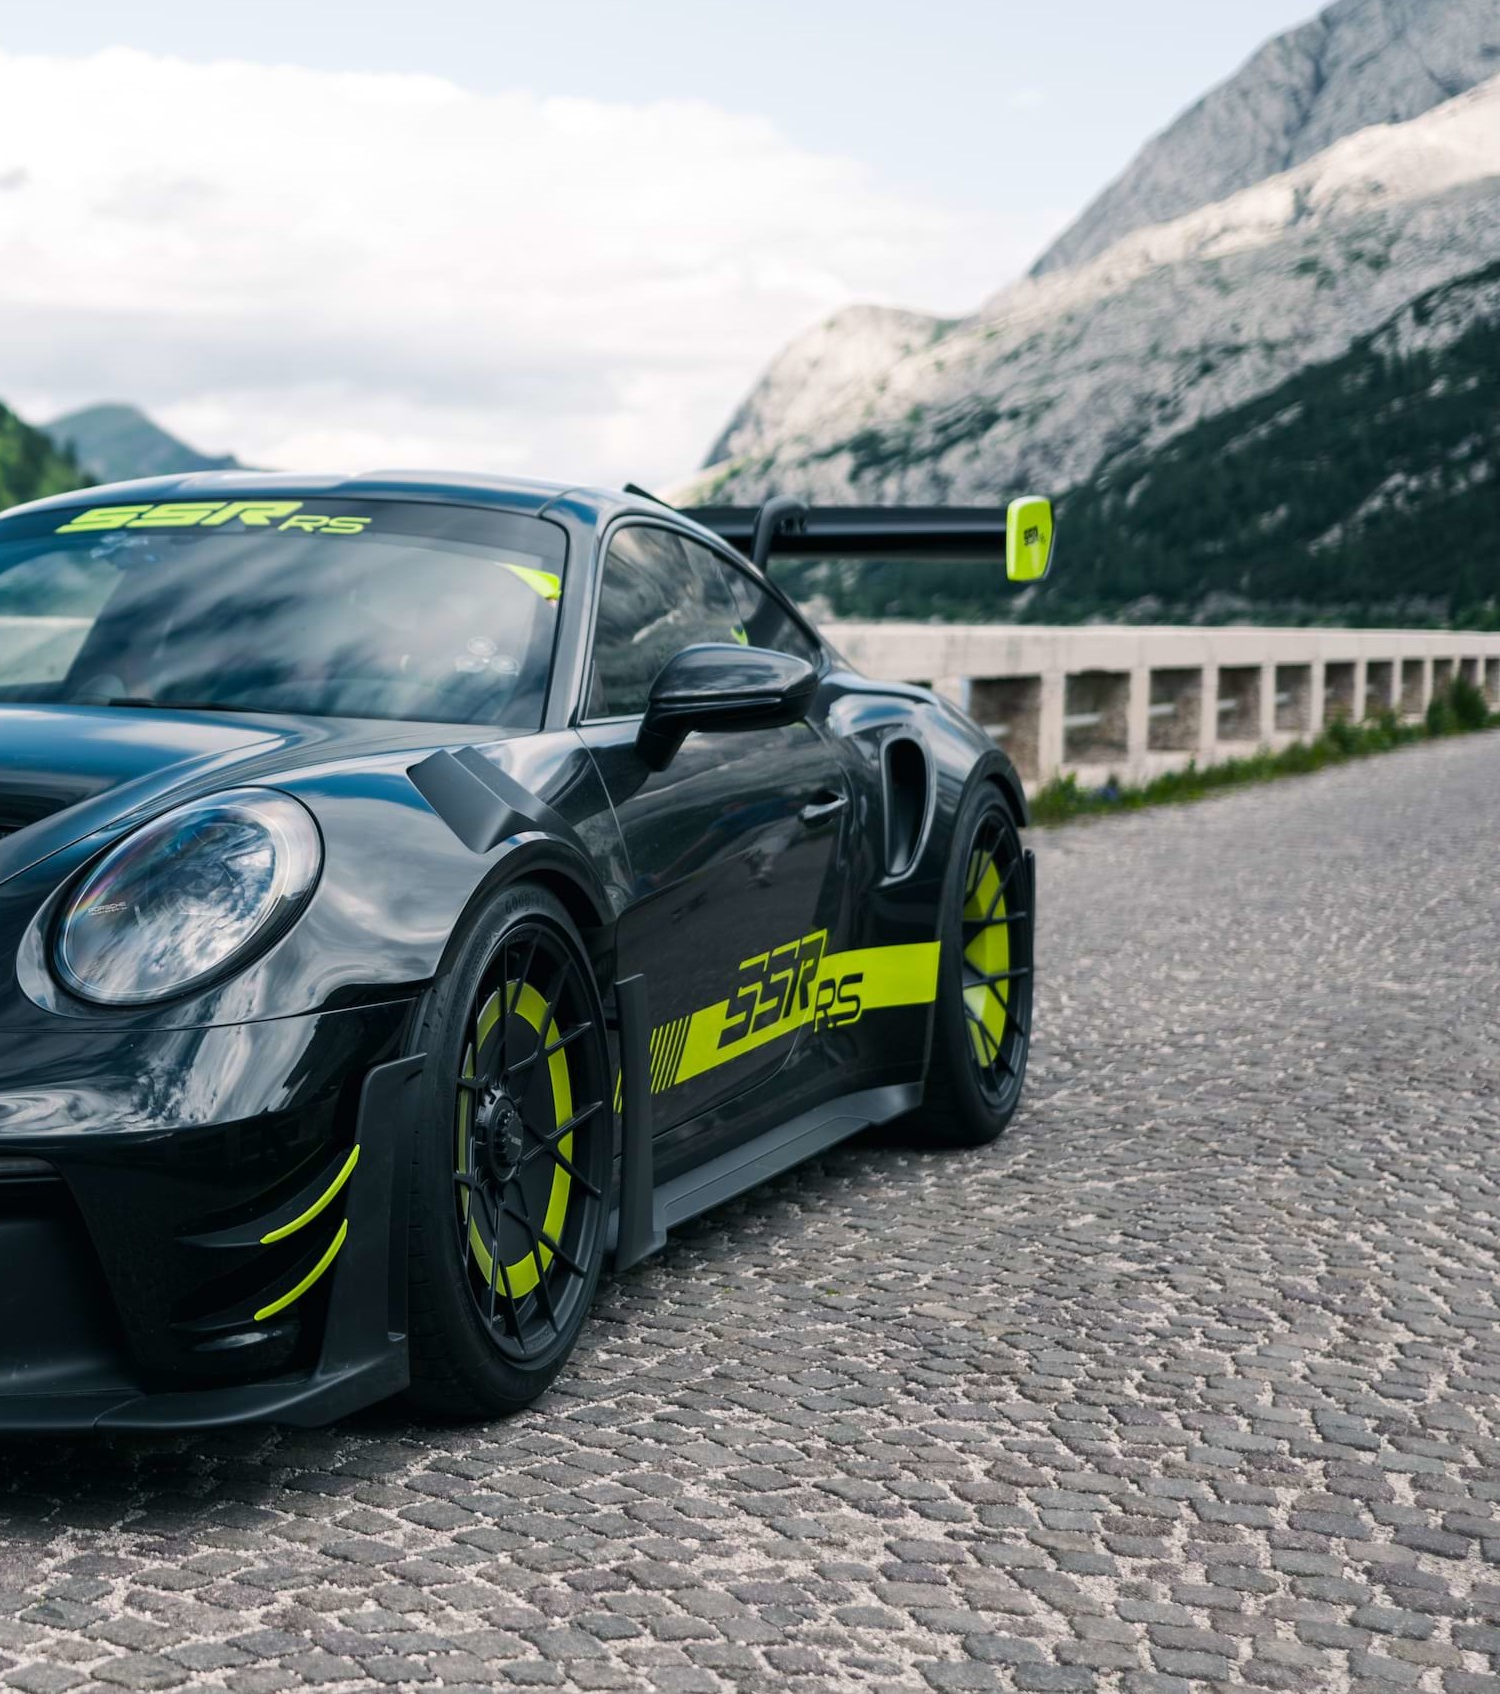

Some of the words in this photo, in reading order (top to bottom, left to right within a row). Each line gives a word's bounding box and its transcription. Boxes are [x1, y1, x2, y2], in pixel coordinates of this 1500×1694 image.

[55, 501, 303, 533] SSR
[277, 515, 373, 534] RS
[717, 928, 827, 1050] SSR
[814, 972, 863, 1033] RS
